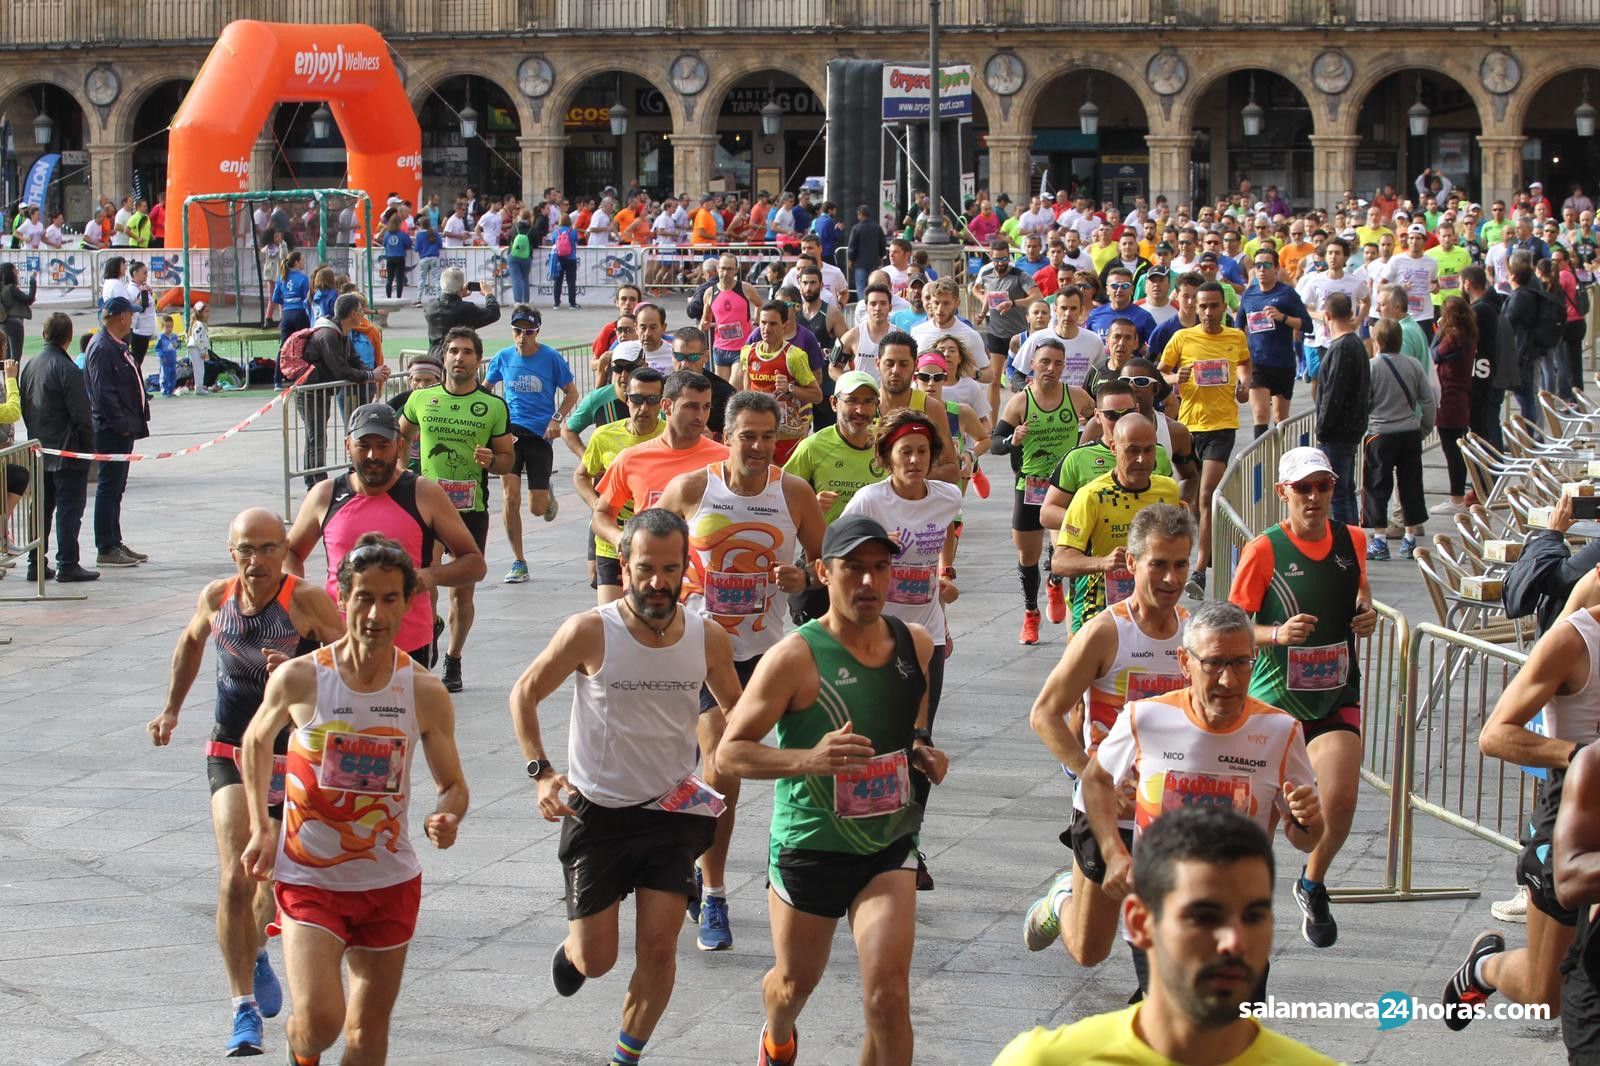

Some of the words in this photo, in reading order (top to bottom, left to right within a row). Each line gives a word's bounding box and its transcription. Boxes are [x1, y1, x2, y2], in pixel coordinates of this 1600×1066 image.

[294, 44, 344, 84] enjoy!
[344, 52, 380, 71] Wellness
[219, 156, 248, 178] enjo
[397, 153, 422, 170] enjo
[29, 160, 51, 208] THLON
[422, 415, 487, 430] CORRECAMINOS
[428, 426, 477, 438] CARBAJOSA
[437, 436, 467, 444] SALAMANCA
[828, 480, 871, 489] CORRECA
[713, 503, 734, 511] MACÍAS
[1130, 651, 1155, 659] RAMÓN
[1302, 661, 1338, 678] 347
[1163, 752, 1185, 761] NICO
[853, 775, 897, 799] 421
